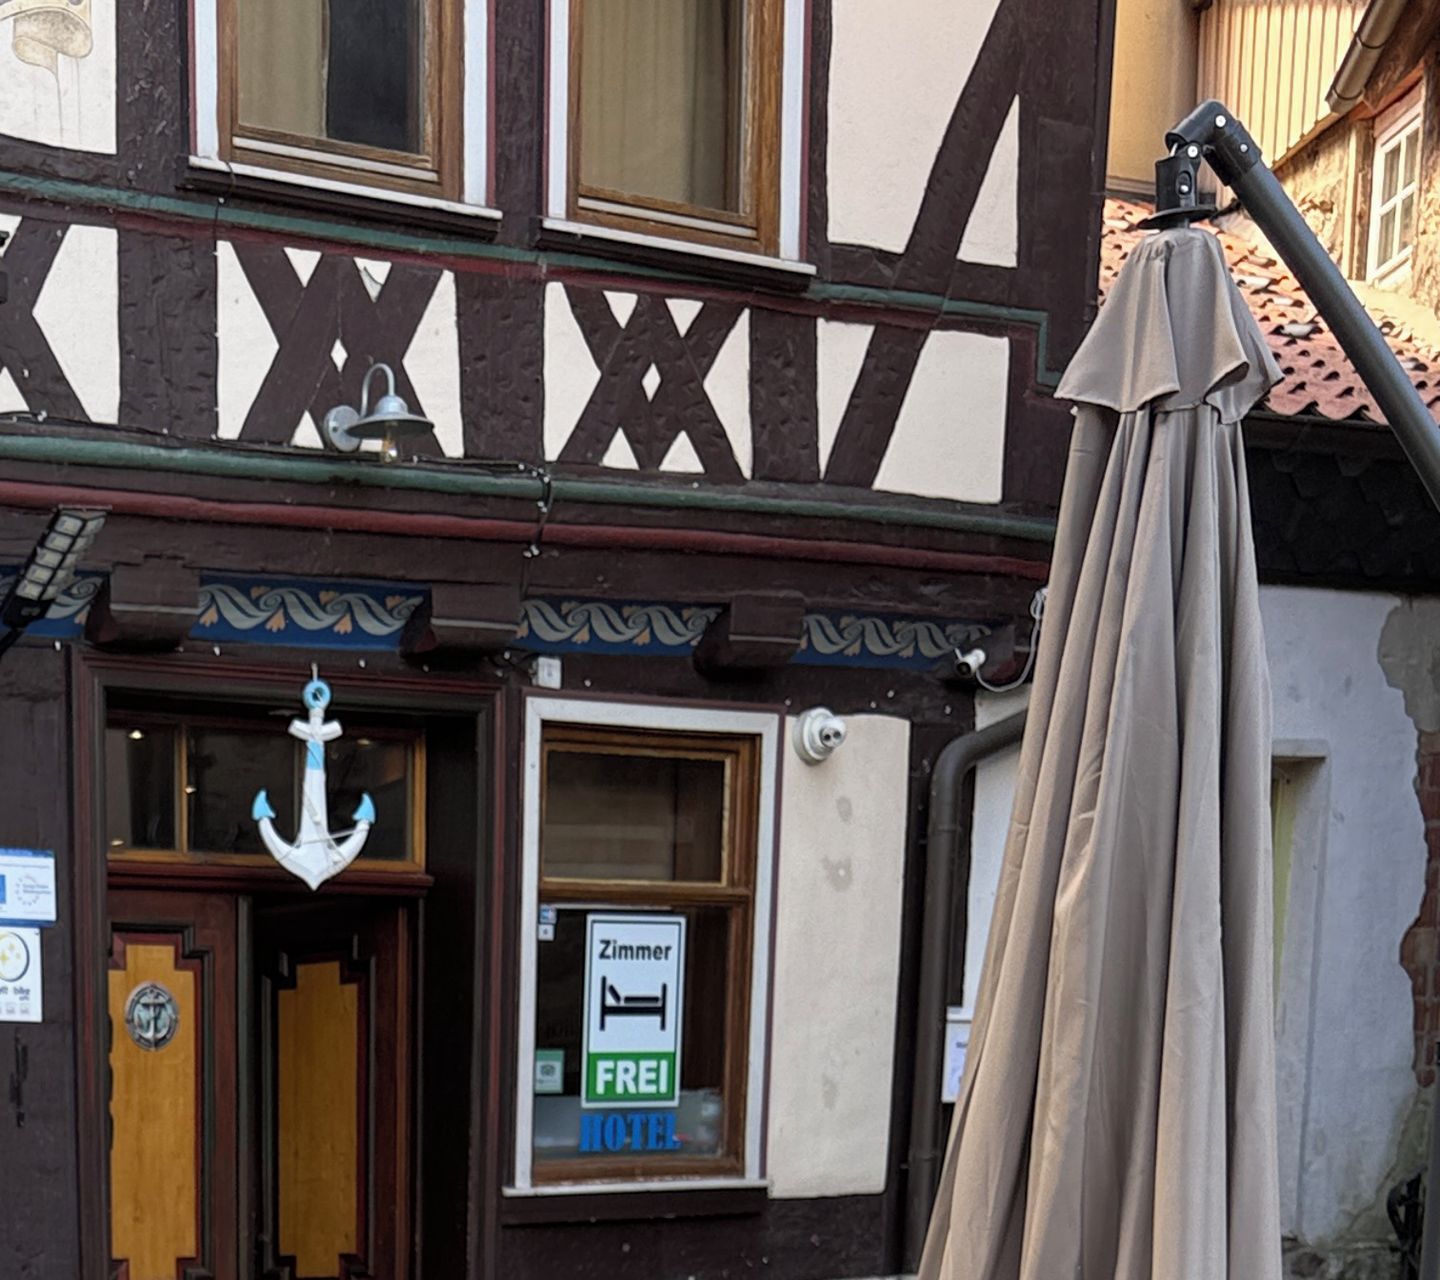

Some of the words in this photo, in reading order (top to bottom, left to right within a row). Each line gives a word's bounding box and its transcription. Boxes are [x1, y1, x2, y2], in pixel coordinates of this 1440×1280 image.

[598, 939, 672, 961] Zimmer
[595, 1059, 669, 1095] FREI
[578, 1112, 682, 1152] HOTEL
